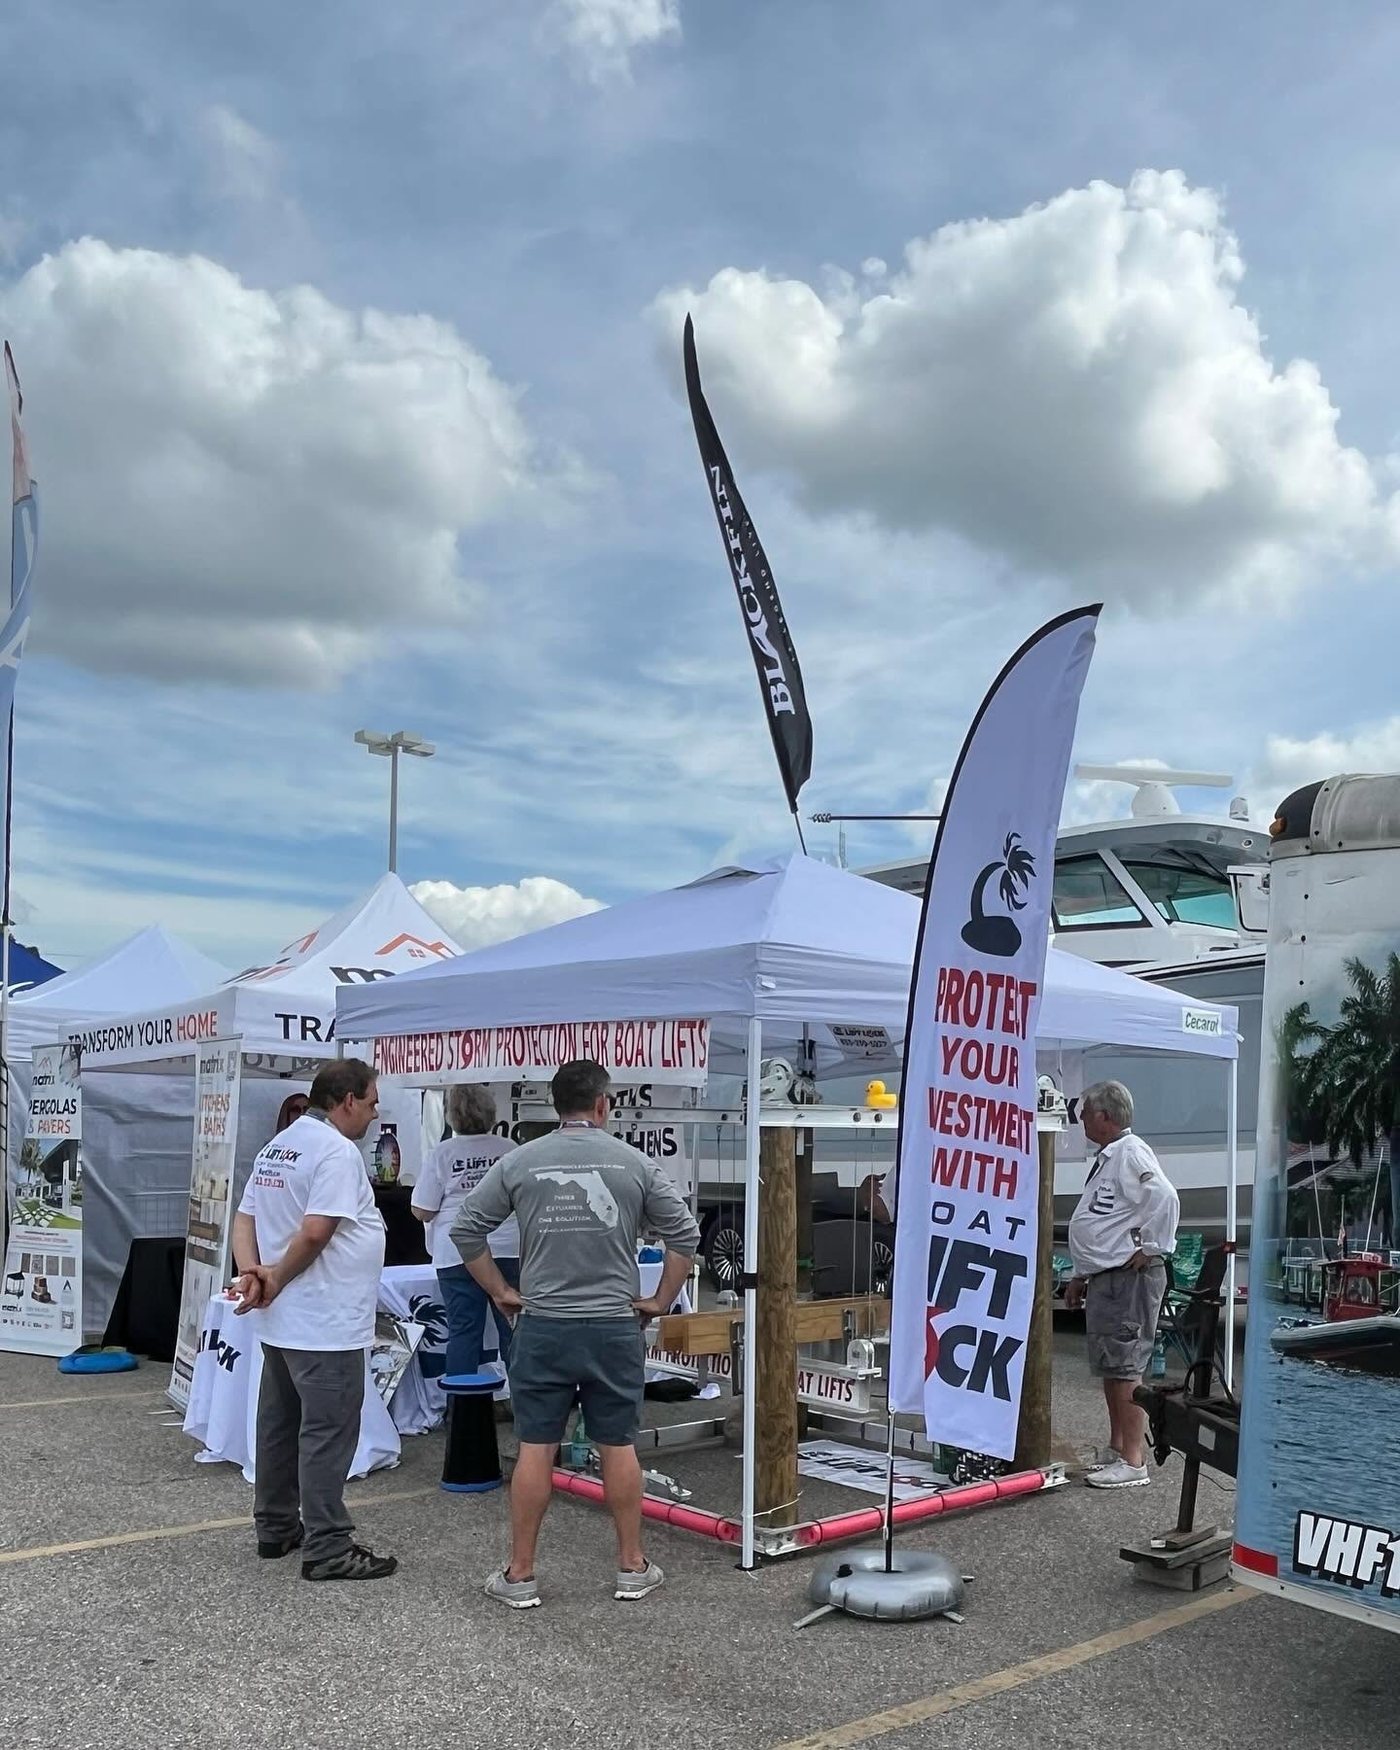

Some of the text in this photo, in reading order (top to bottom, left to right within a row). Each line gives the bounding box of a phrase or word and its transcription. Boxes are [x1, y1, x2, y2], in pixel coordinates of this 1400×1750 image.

[138, 1018, 173, 1045] YOUR
[177, 1011, 218, 1041] HOME
[934, 967, 1037, 1041] PROTET
[373, 1031, 443, 1075] ENGINEERED
[495, 1022, 577, 1067] PROTECTION
[582, 1021, 609, 1067] FOR
[615, 1020, 656, 1068] BOAT
[661, 1018, 708, 1069] LIFTS
[942, 1035, 1018, 1089] YOUR
[931, 1144, 1018, 1200] WITH
[818, 1374, 856, 1402] LIFTS
